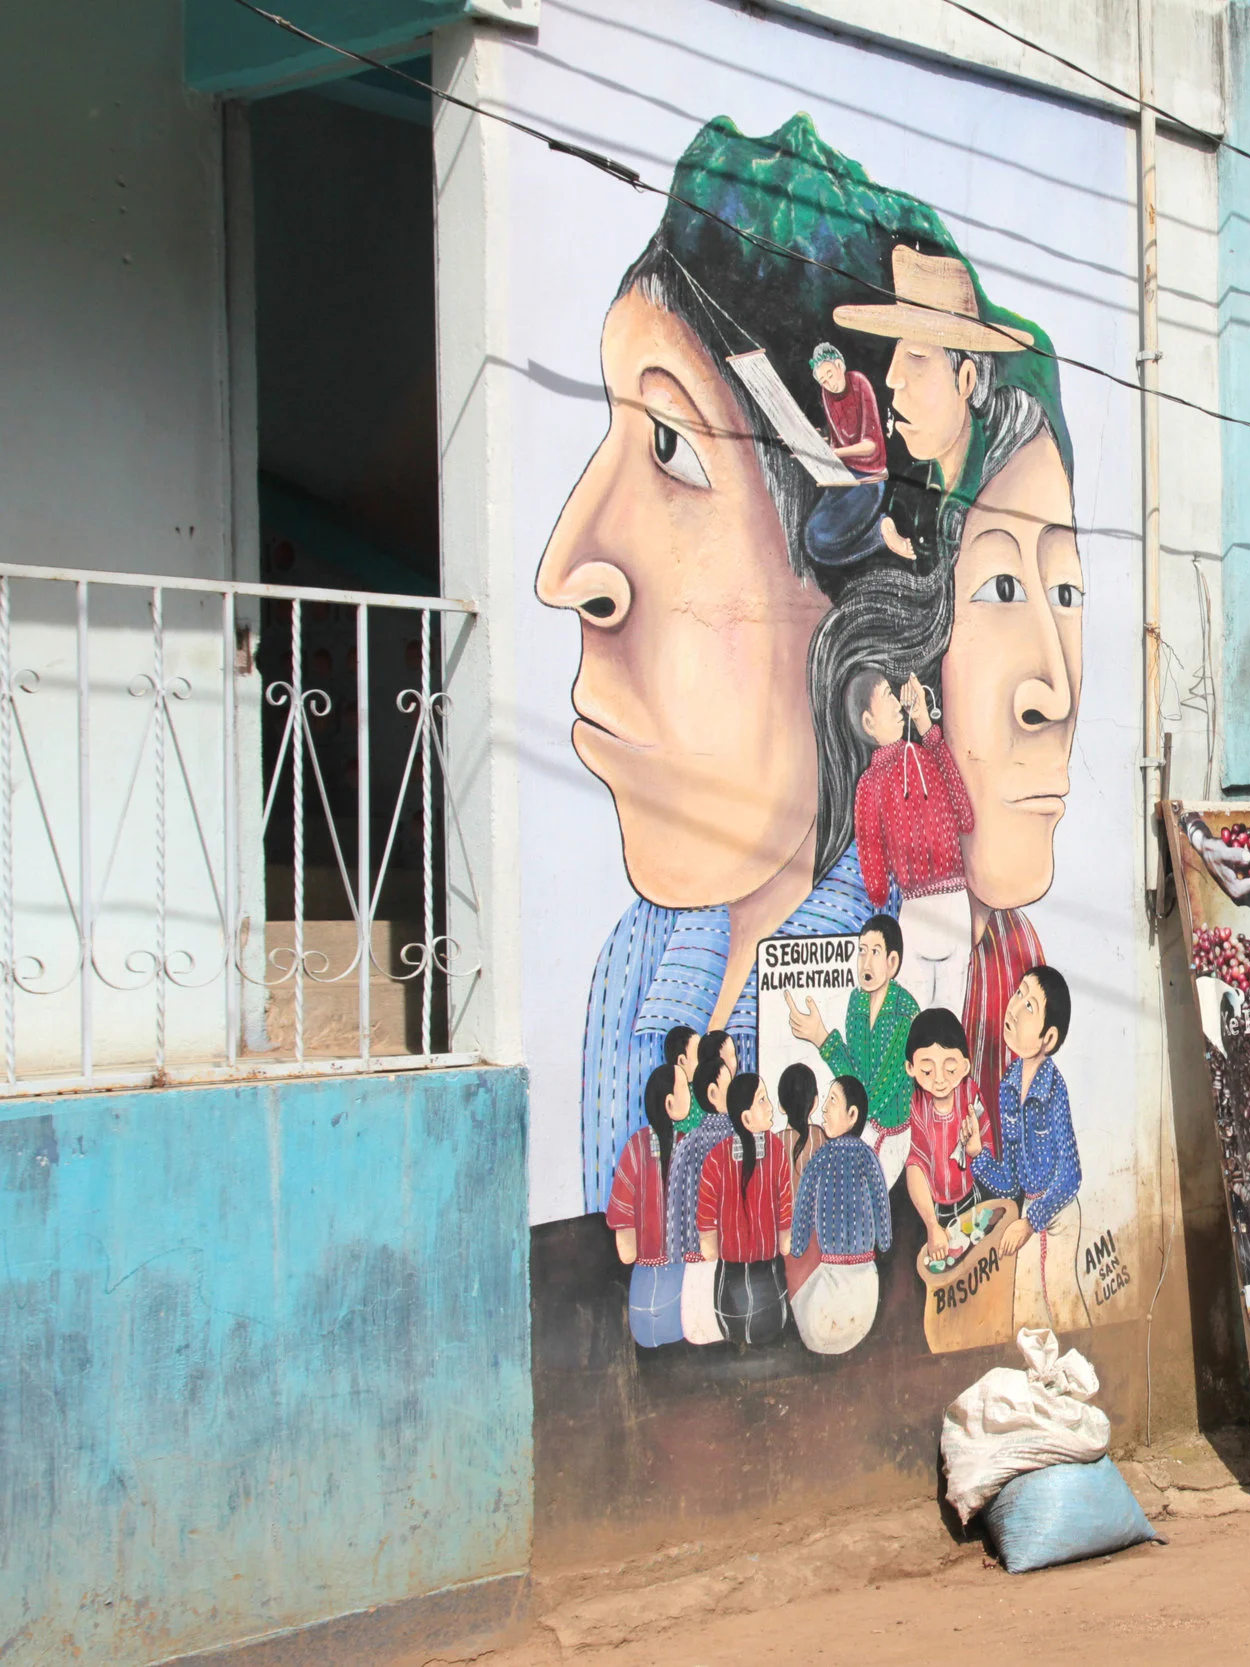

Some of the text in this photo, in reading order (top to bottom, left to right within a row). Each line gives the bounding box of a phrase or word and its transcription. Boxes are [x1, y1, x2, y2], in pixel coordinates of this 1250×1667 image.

[765, 940, 856, 968] SEGURIDAD
[760, 967, 856, 991] ALIMENTARIA
[1085, 1229, 1117, 1275] AMI
[1099, 1256, 1120, 1282] SAN
[933, 1246, 1000, 1315] BASURA
[1095, 1265, 1131, 1306] LUCAS
